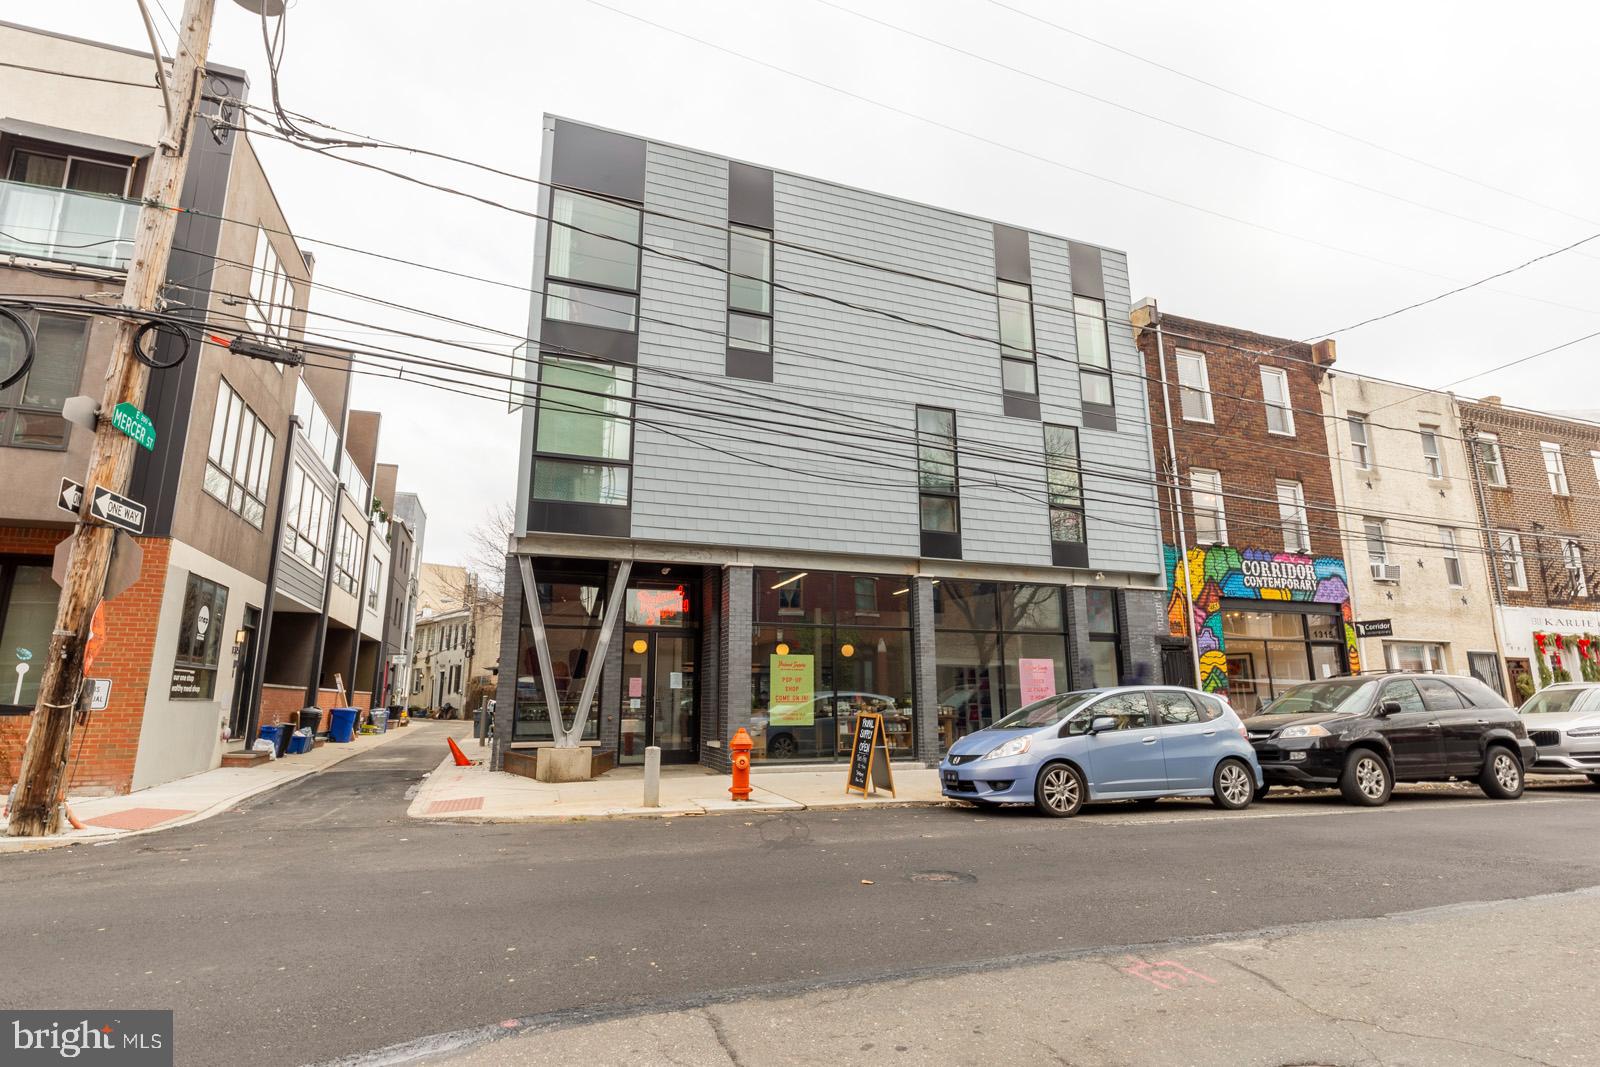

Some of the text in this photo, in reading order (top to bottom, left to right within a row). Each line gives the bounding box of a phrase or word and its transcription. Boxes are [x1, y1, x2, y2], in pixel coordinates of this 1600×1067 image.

[113, 408, 154, 449] MERCER ST
[107, 501, 139, 523] ONE WAY
[1241, 560, 1317, 580] CORRIDOR
[1243, 576, 1317, 591] CONTEMPORARY
[1365, 622, 1390, 631] Corridor
[1544, 618, 1593, 628] KARLIE
[858, 743, 871, 753] OPEN
